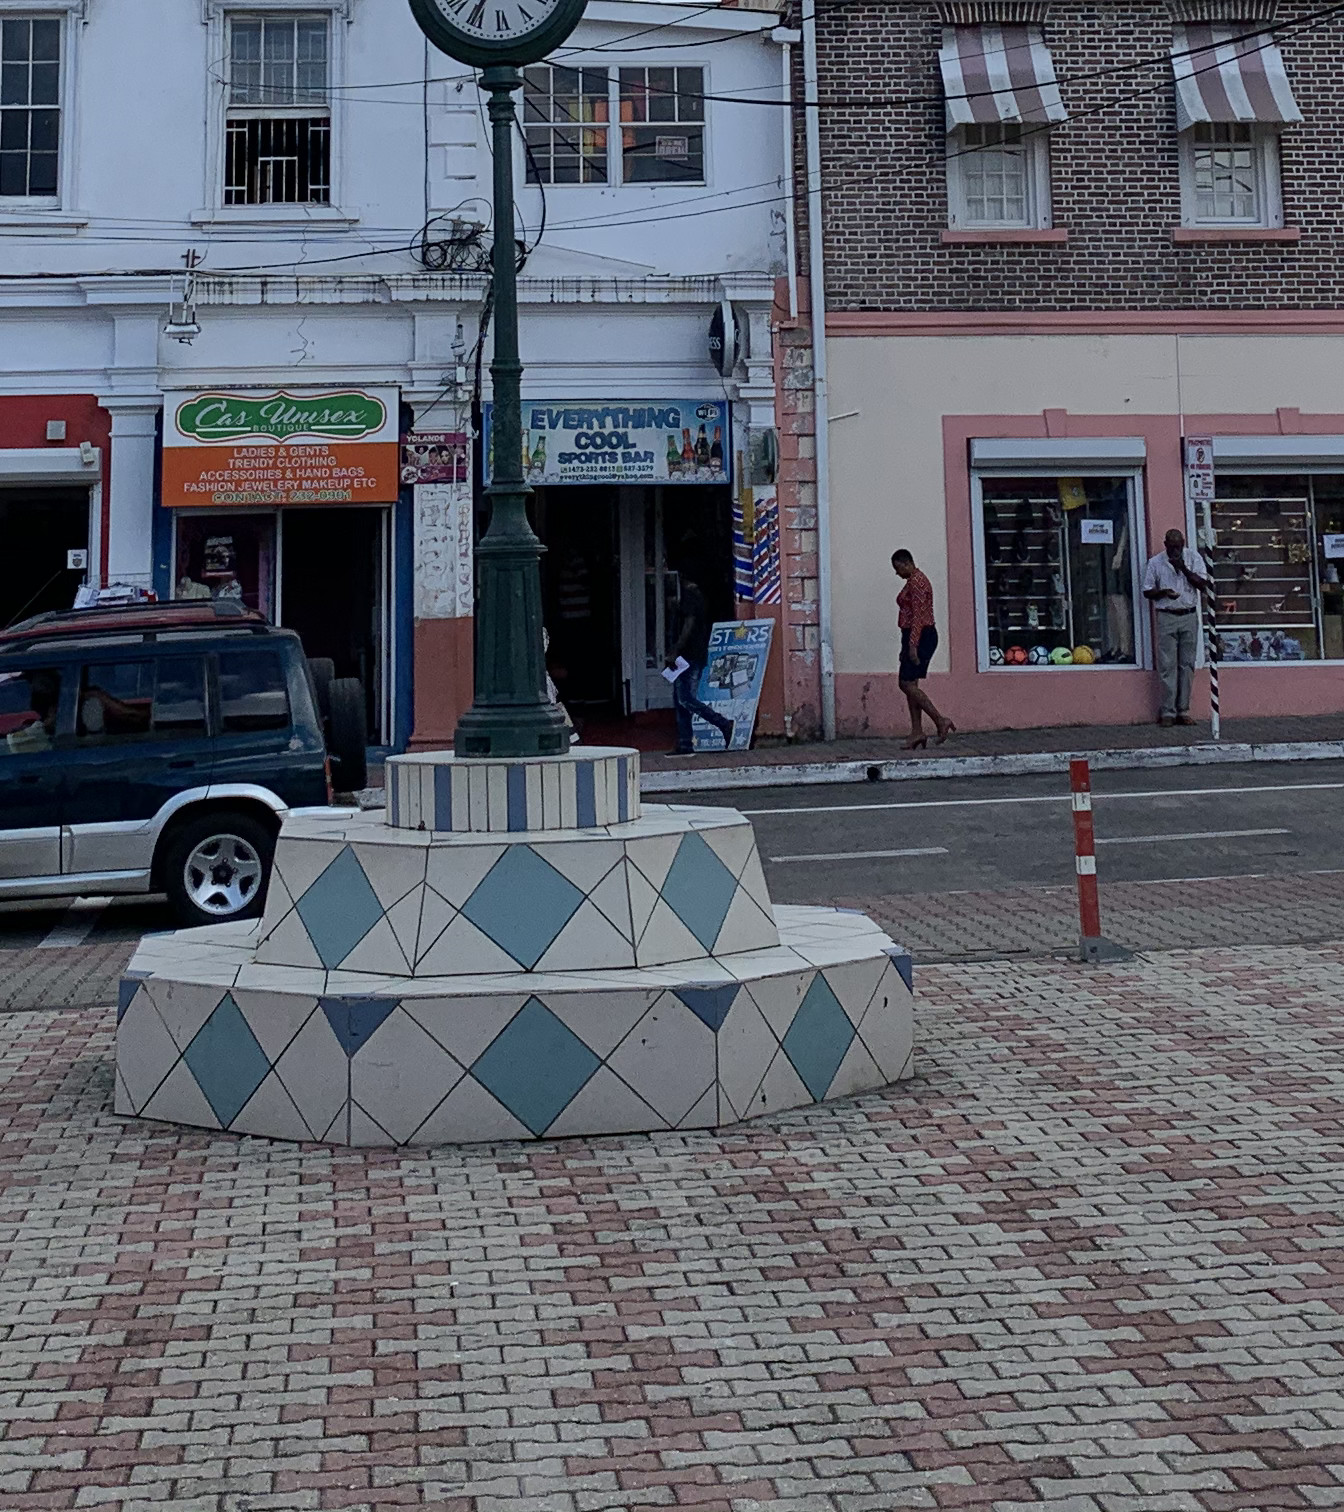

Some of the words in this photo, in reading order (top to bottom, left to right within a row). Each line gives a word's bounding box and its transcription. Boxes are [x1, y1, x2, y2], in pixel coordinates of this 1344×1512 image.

[496, 10, 511, 31] VI
[518, 4, 534, 24] V
[195, 400, 253, 427] Cas
[260, 400, 368, 426] Unisex
[530, 406, 681, 430] EVERYTHING
[253, 424, 309, 433] BOUTIQUE
[574, 431, 637, 450] COOL
[234, 448, 276, 458] LADIES
[278, 447, 287, 457] &
[290, 446, 329, 456] GENTS
[557, 451, 618, 465] SPORTS
[621, 451, 655, 464] BAR
[228, 458, 274, 469] TRENDY
[277, 456, 337, 467] CLOTHING
[199, 470, 282, 481] ACCESSORIES
[285, 469, 294, 479] &
[296, 468, 330, 478] HAND
[332, 467, 365, 477] BAGS
[184, 482, 235, 493] FASHION
[237, 481, 300, 492] JEWELERY
[301, 479, 350, 489] MAKEUP
[353, 478, 377, 488] ETC
